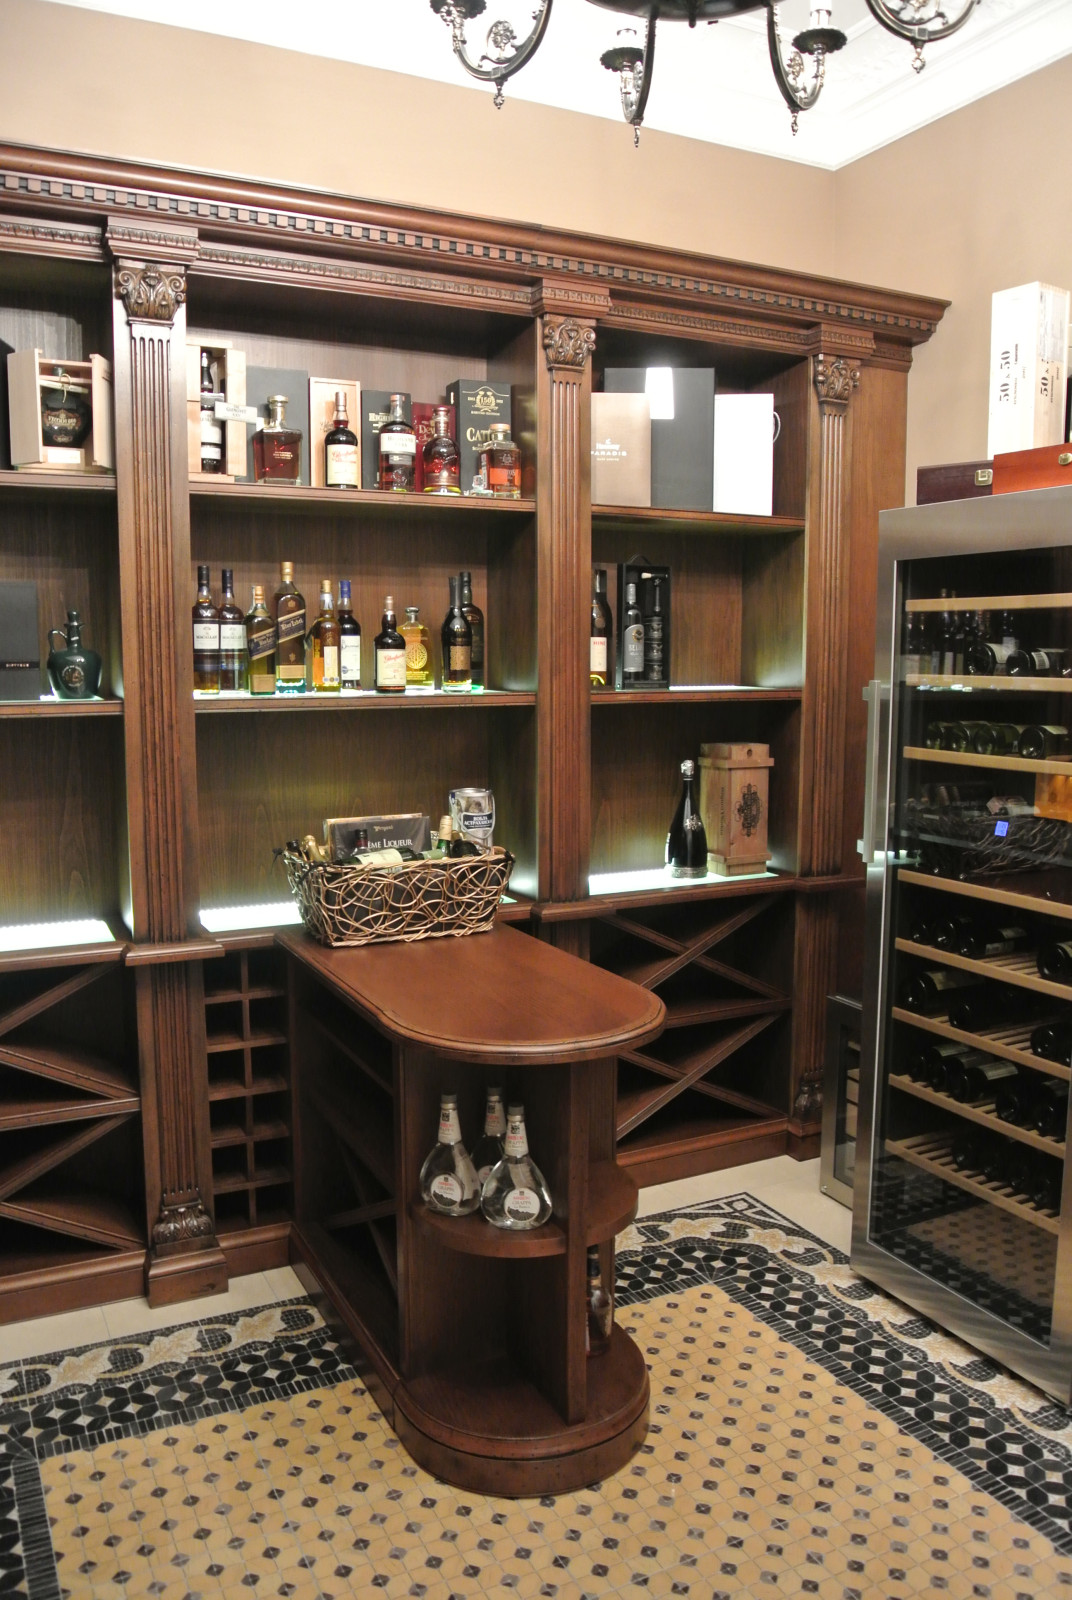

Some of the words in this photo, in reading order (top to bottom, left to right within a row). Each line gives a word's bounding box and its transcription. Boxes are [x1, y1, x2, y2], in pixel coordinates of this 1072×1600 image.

[1000, 350, 1011, 370] 50
[1000, 383, 1010, 402] 50
[1040, 376, 1049, 397] 50
[466, 427, 492, 442] CATT
[382, 837, 414, 849] LIQUEUR
